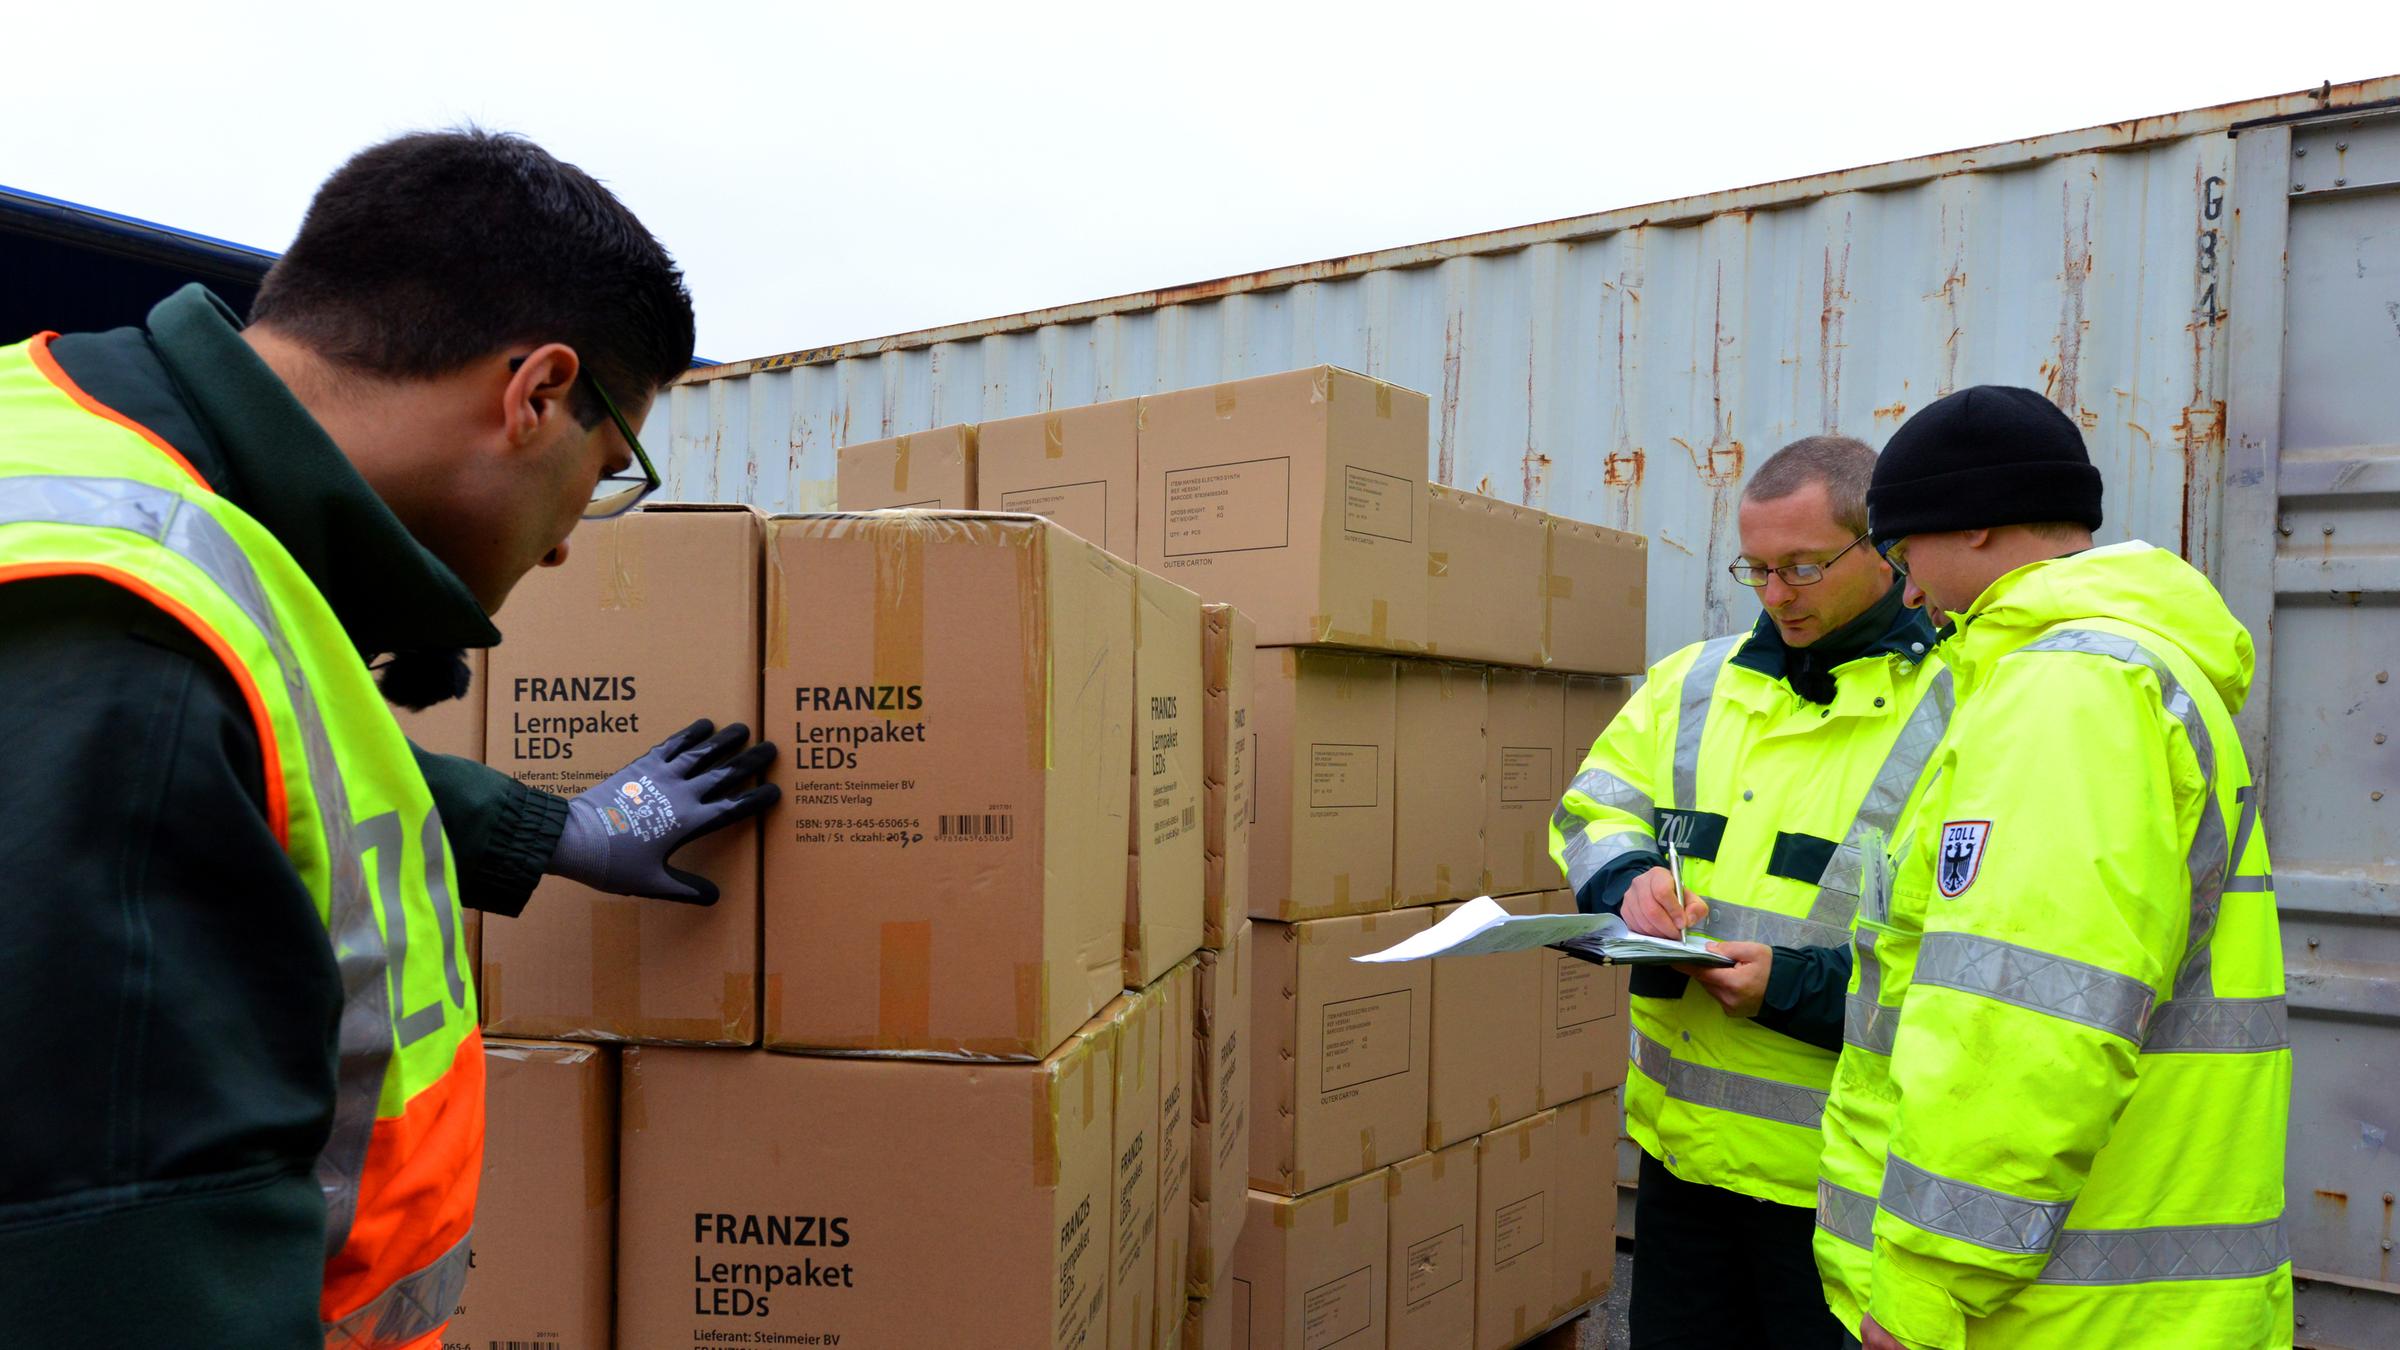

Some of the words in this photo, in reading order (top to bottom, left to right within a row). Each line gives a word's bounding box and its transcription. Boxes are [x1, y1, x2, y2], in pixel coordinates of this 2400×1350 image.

[1163, 558, 1186, 569] OUTER
[1187, 556, 1213, 568] CARTON
[514, 676, 636, 702] FRANZIS
[796, 685, 923, 711] FRANZIS
[1151, 696, 1177, 720] FRANZIS
[514, 710, 639, 738] Lernpaket
[796, 720, 925, 748] Lernpaket
[514, 738, 573, 760] LEDs
[1152, 727, 1178, 754] Lernpaket
[796, 747, 857, 769] LEDs
[1153, 753, 1166, 776] LEDs
[513, 770, 559, 782] Lieferant:
[795, 780, 842, 792] Lieferant:
[845, 780, 899, 791] Steinmeier
[902, 780, 915, 790] BV
[795, 795, 838, 805] FRANZIS
[841, 794, 873, 806] Verlag
[796, 819, 822, 829] ISBN:
[824, 819, 919, 829] 978-3-645-65065-6
[1658, 813, 1696, 849] ZOLL
[1948, 827, 1975, 841] ZOLL
[796, 832, 826, 843] Inhalt
[1320, 1093, 1338, 1105] OUTER
[1338, 1089, 1360, 1102] CARTON
[1120, 1130, 1143, 1178] FRANZIS
[1060, 1193, 1090, 1252] FRANZIS
[1120, 1198, 1132, 1227] LEDs
[695, 1213, 850, 1248] FRANZIS
[1060, 1227, 1090, 1283] Lernpaket
[695, 1256, 853, 1292] Lernpaket
[695, 1288, 769, 1318] LEDs
[1060, 1274, 1075, 1309] LEDs
[694, 1330, 751, 1343] Lieferant:
[754, 1331, 820, 1345] Steinmeier
[823, 1334, 841, 1346] BV
